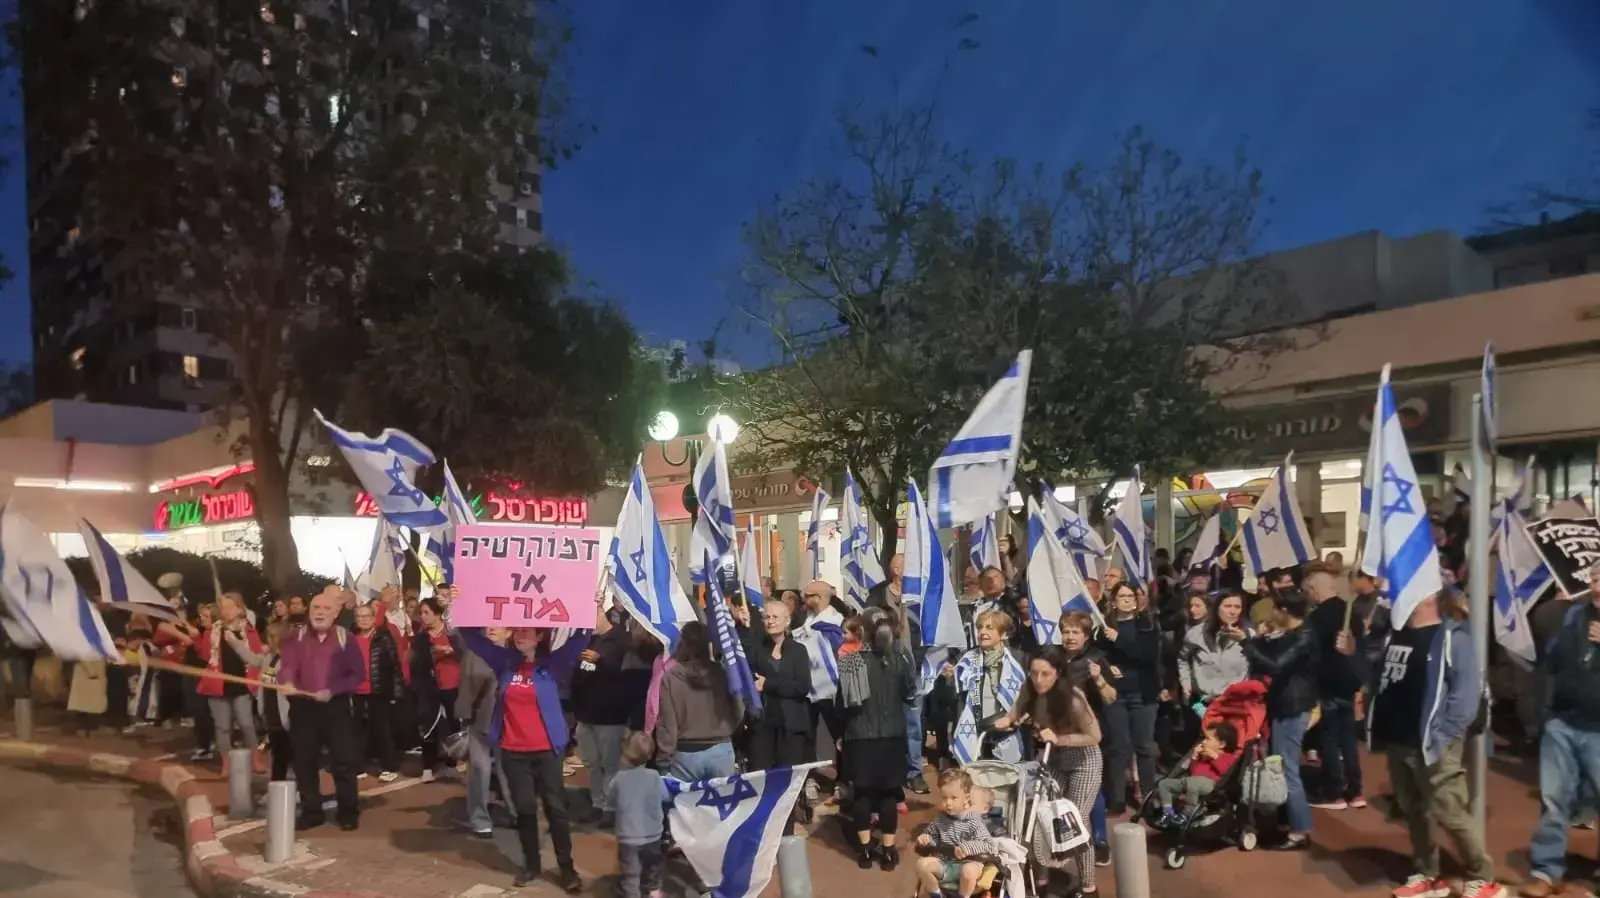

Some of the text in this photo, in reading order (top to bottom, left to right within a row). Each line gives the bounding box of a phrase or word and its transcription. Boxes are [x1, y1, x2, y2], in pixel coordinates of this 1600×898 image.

[202, 491, 253, 522] שופרסל
[487, 493, 588, 523] שופרסל
[461, 536, 600, 567] דמוקרטיה
[511, 572, 547, 594] או
[486, 596, 570, 622] מרד
